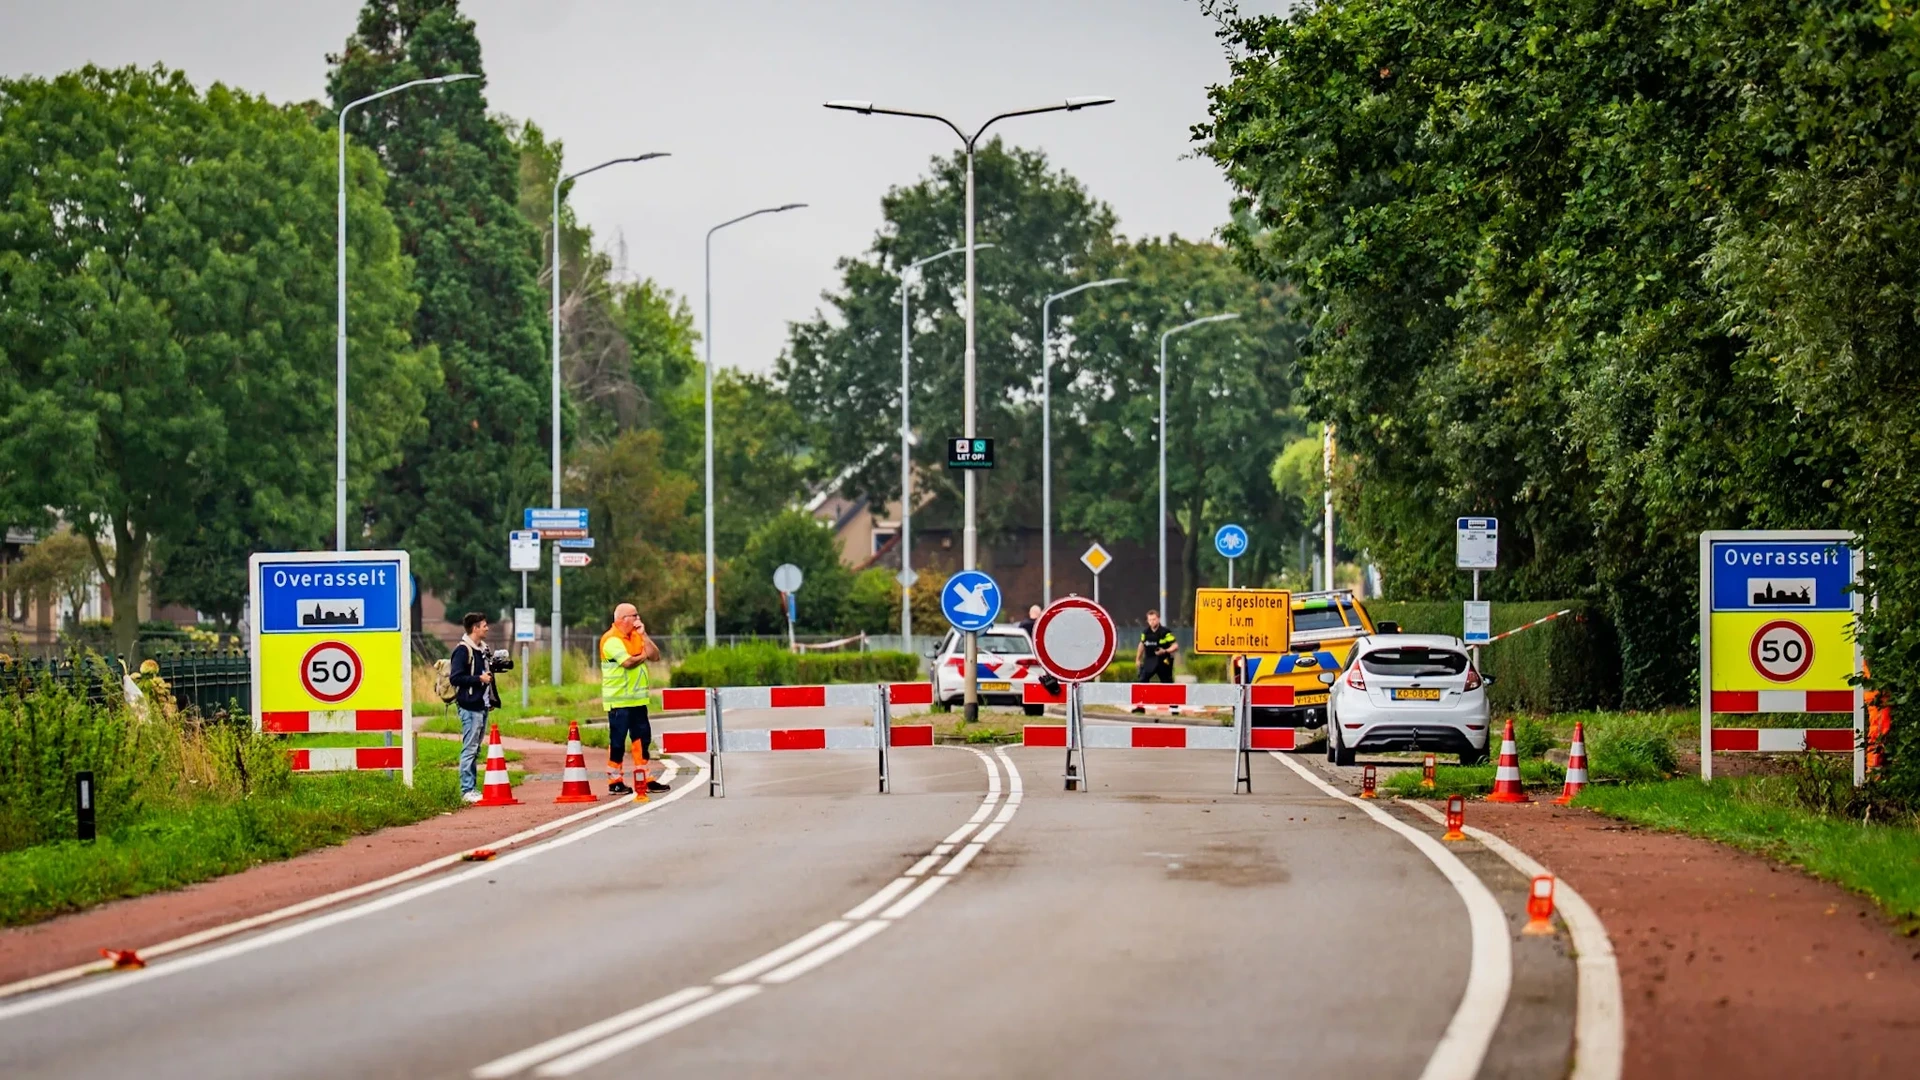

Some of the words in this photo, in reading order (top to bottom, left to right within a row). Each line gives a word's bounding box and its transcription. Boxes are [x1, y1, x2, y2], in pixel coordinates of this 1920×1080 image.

[957, 453, 970, 461] LET
[971, 453, 985, 461] OP!
[1724, 548, 1839, 566] Overasselt
[274, 569, 386, 587] Overasselt
[1202, 597, 1222, 611] weg
[1226, 595, 1283, 611] afgesloten
[1229, 614, 1254, 627] i.v.m
[1214, 633, 1269, 647] calamiteit
[1762, 640, 1803, 663] 50
[312, 661, 351, 683] 50
